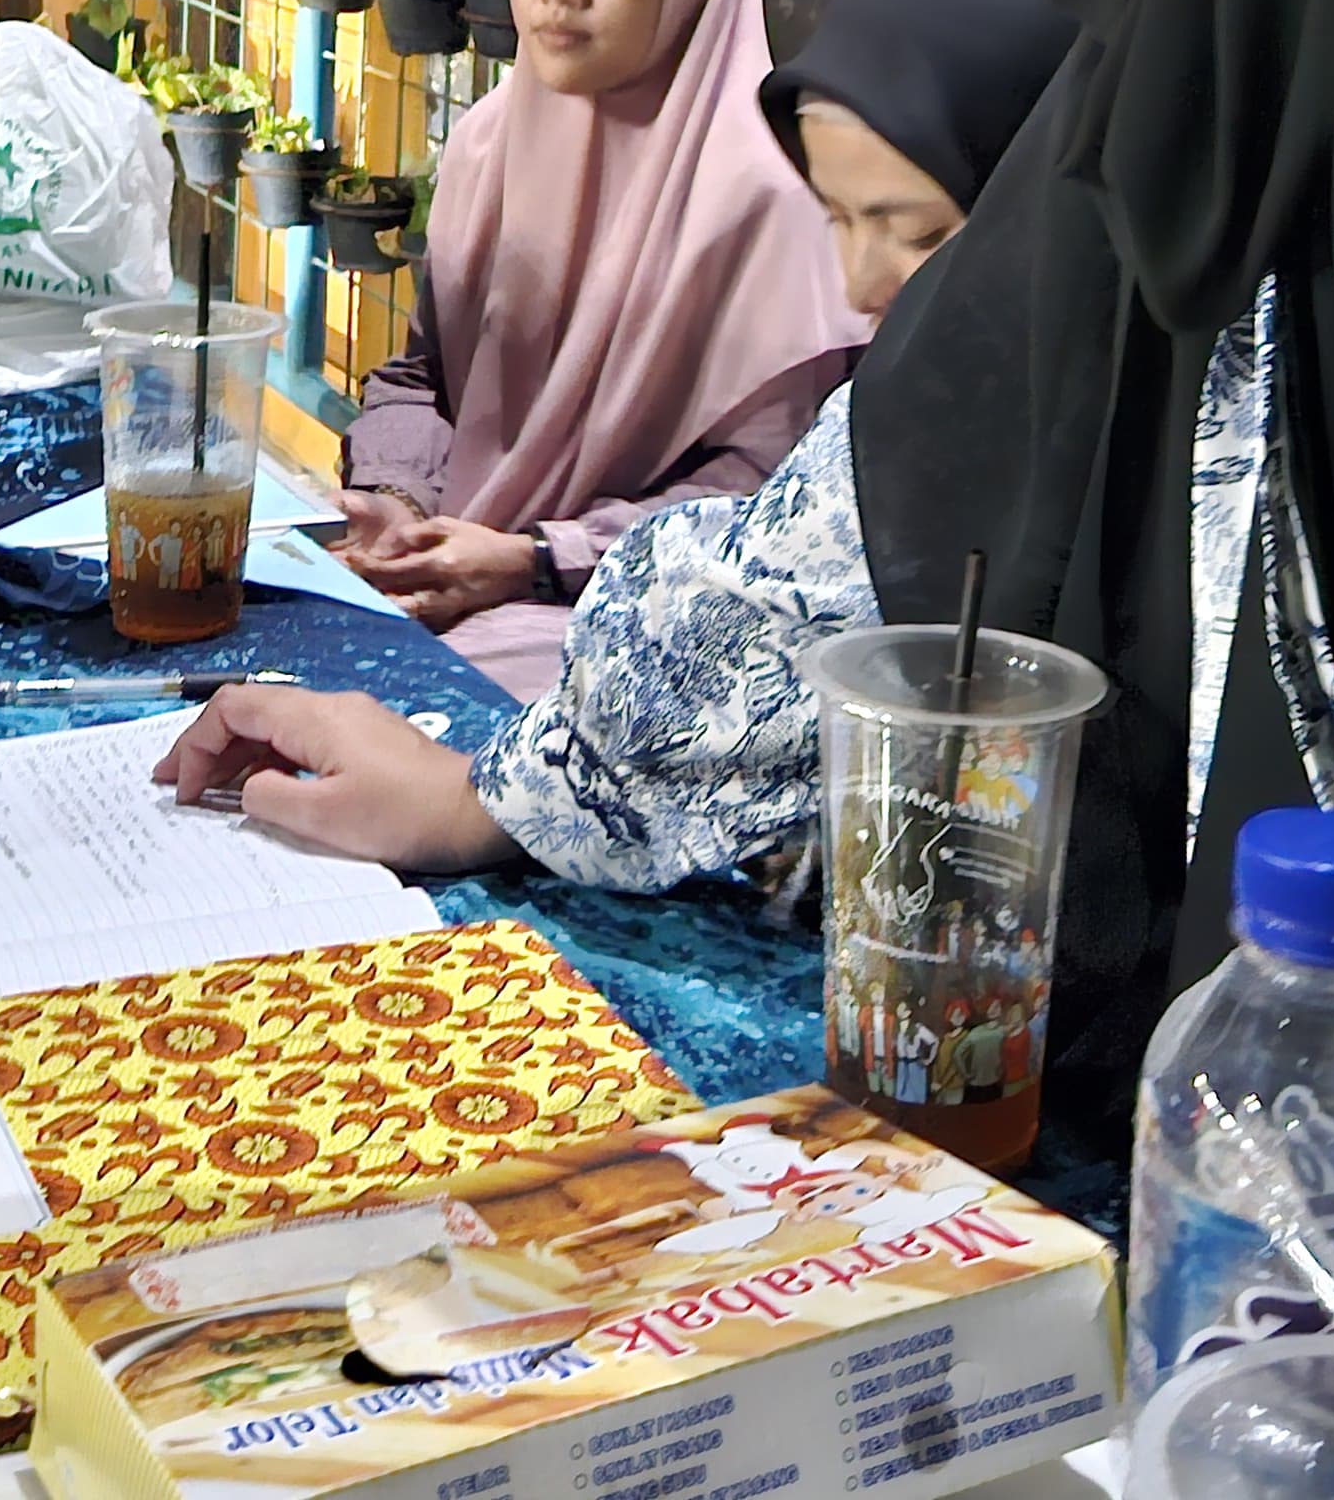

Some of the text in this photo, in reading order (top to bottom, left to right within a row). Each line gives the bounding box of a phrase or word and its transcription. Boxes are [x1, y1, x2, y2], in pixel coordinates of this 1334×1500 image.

[226, 1207, 1033, 1451] Martabak Manis dan Telor
